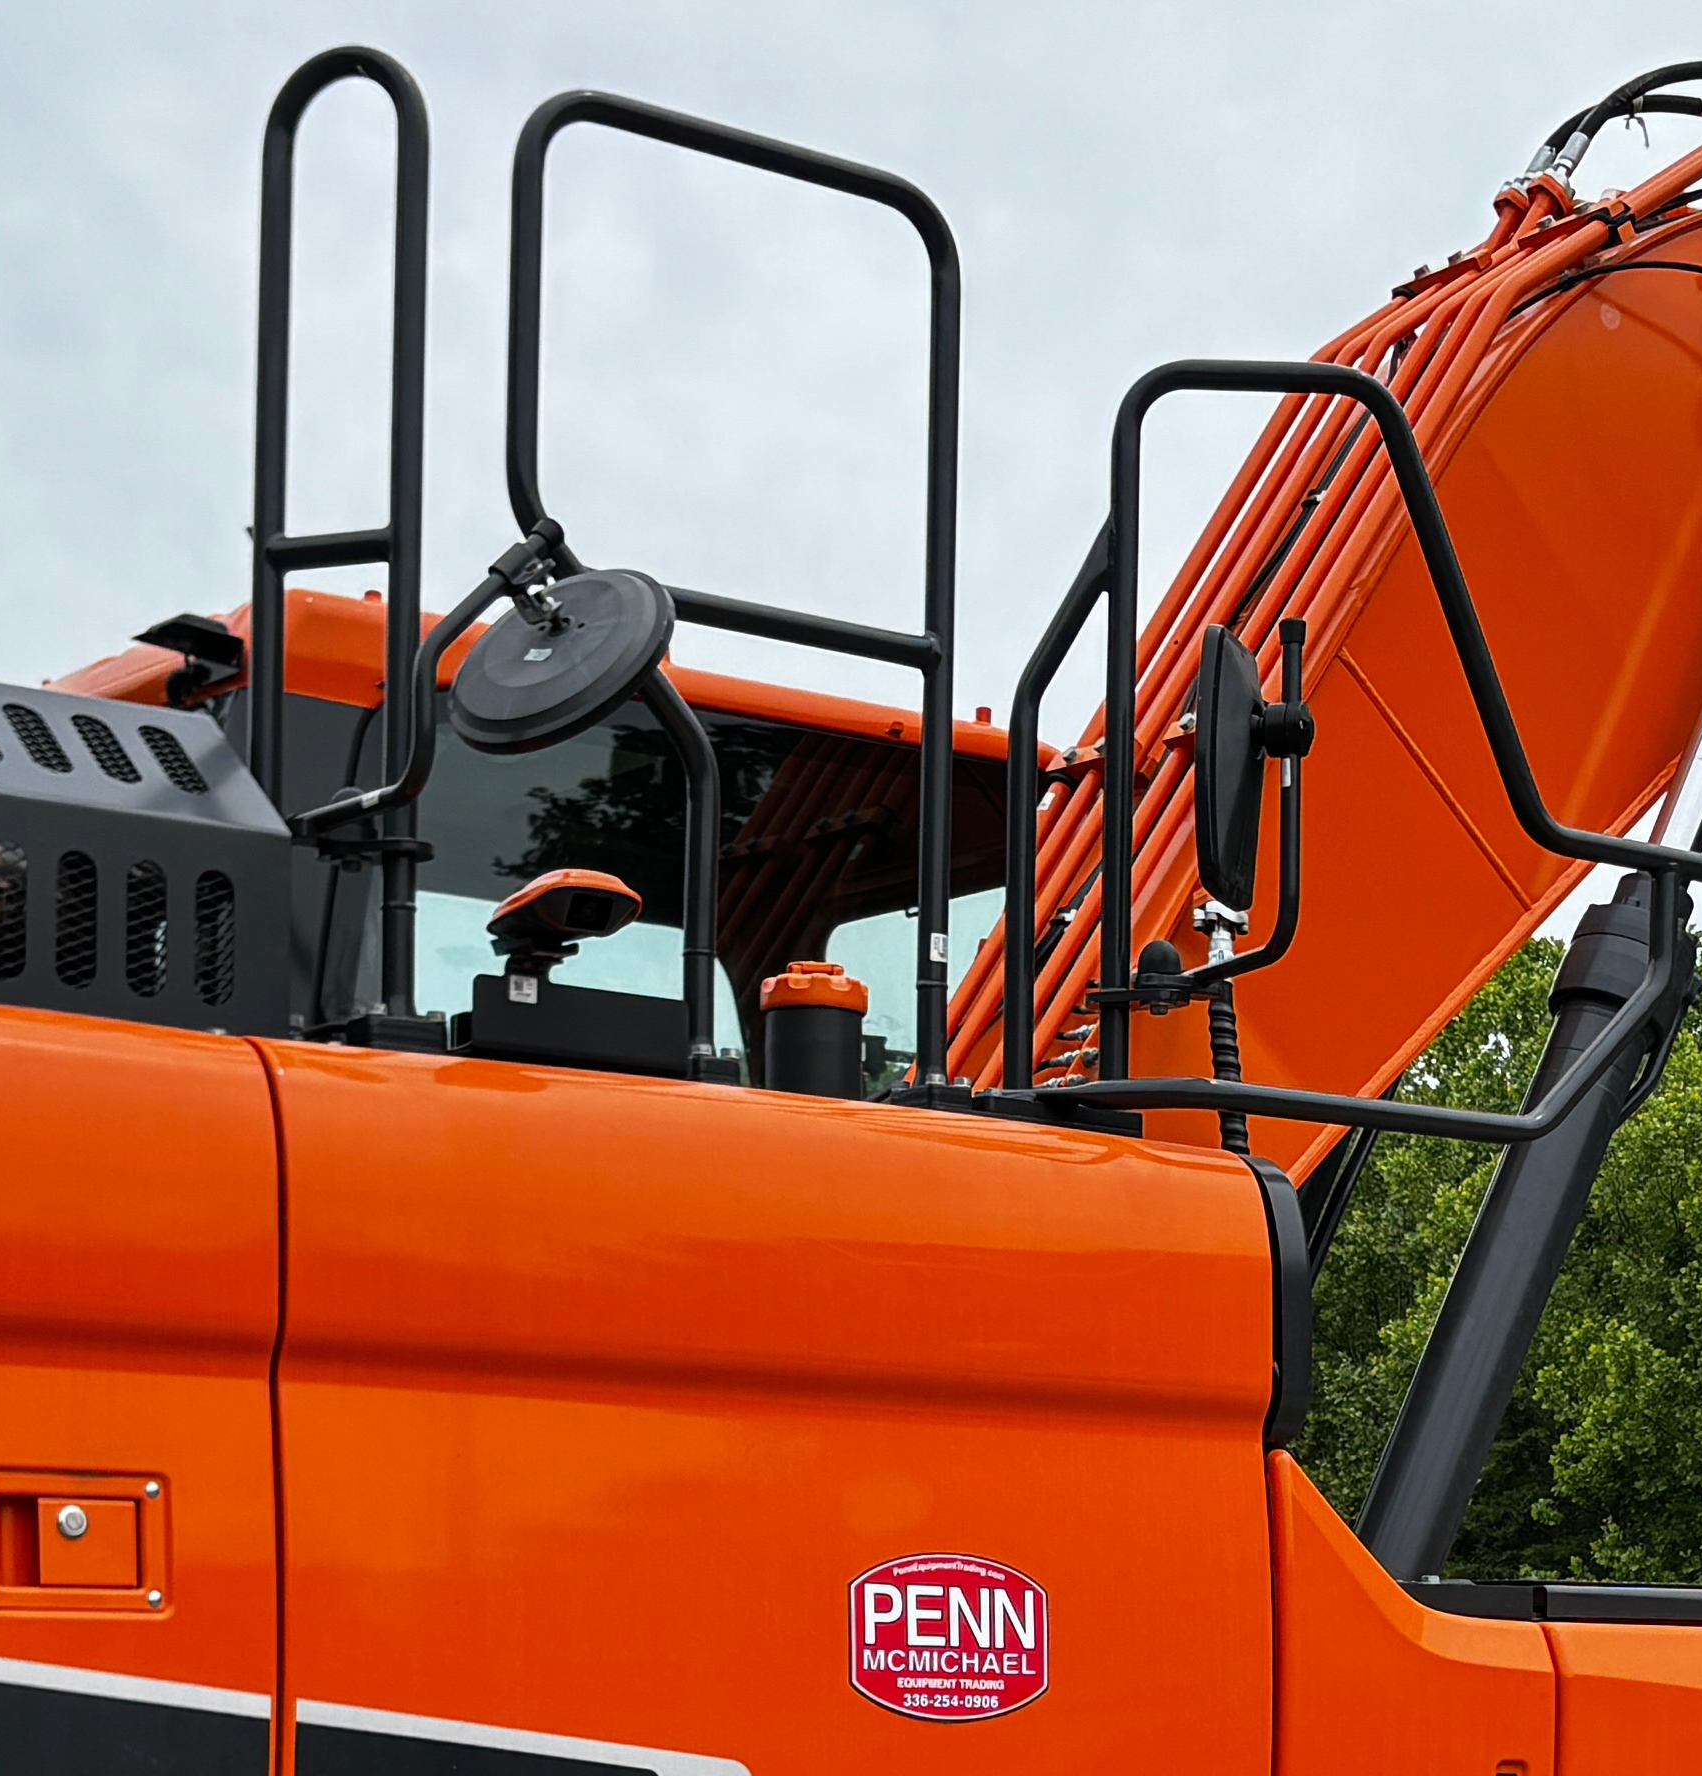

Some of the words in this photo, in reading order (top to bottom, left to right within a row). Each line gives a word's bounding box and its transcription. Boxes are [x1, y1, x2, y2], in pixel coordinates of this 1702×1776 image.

[863, 1582, 1037, 1650] PENN
[862, 1648, 1037, 1676] MCMICHAEL
[896, 1676, 957, 1690] EQUIPMENT
[959, 1677, 1005, 1691] TRADING
[902, 1693, 999, 1709] 336-254-0906
